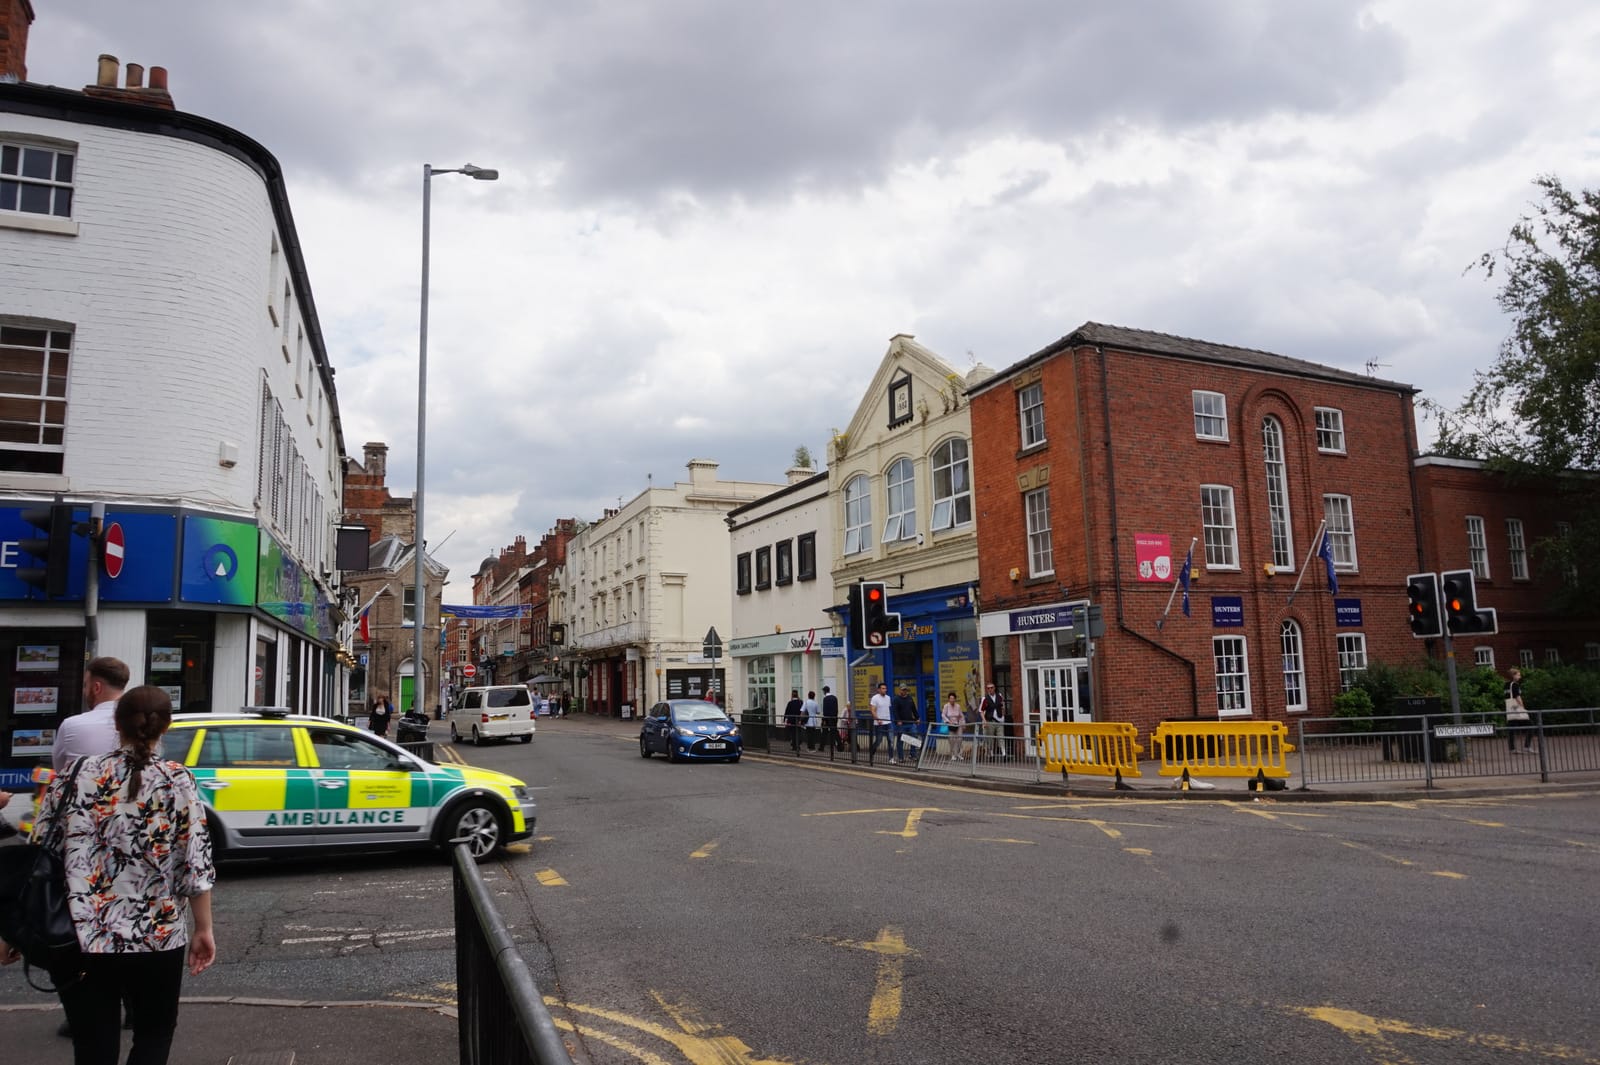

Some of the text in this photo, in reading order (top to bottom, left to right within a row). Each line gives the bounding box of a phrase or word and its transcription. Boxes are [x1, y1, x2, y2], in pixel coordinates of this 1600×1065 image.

[1017, 612, 1056, 626] HUNTERS
[790, 636, 809, 649] Studio
[804, 628, 816, 654] 2
[1436, 725, 1492, 736] WIGFORD WAY
[0, 772, 31, 785] TTIN
[264, 810, 405, 827] AMBULANCE
